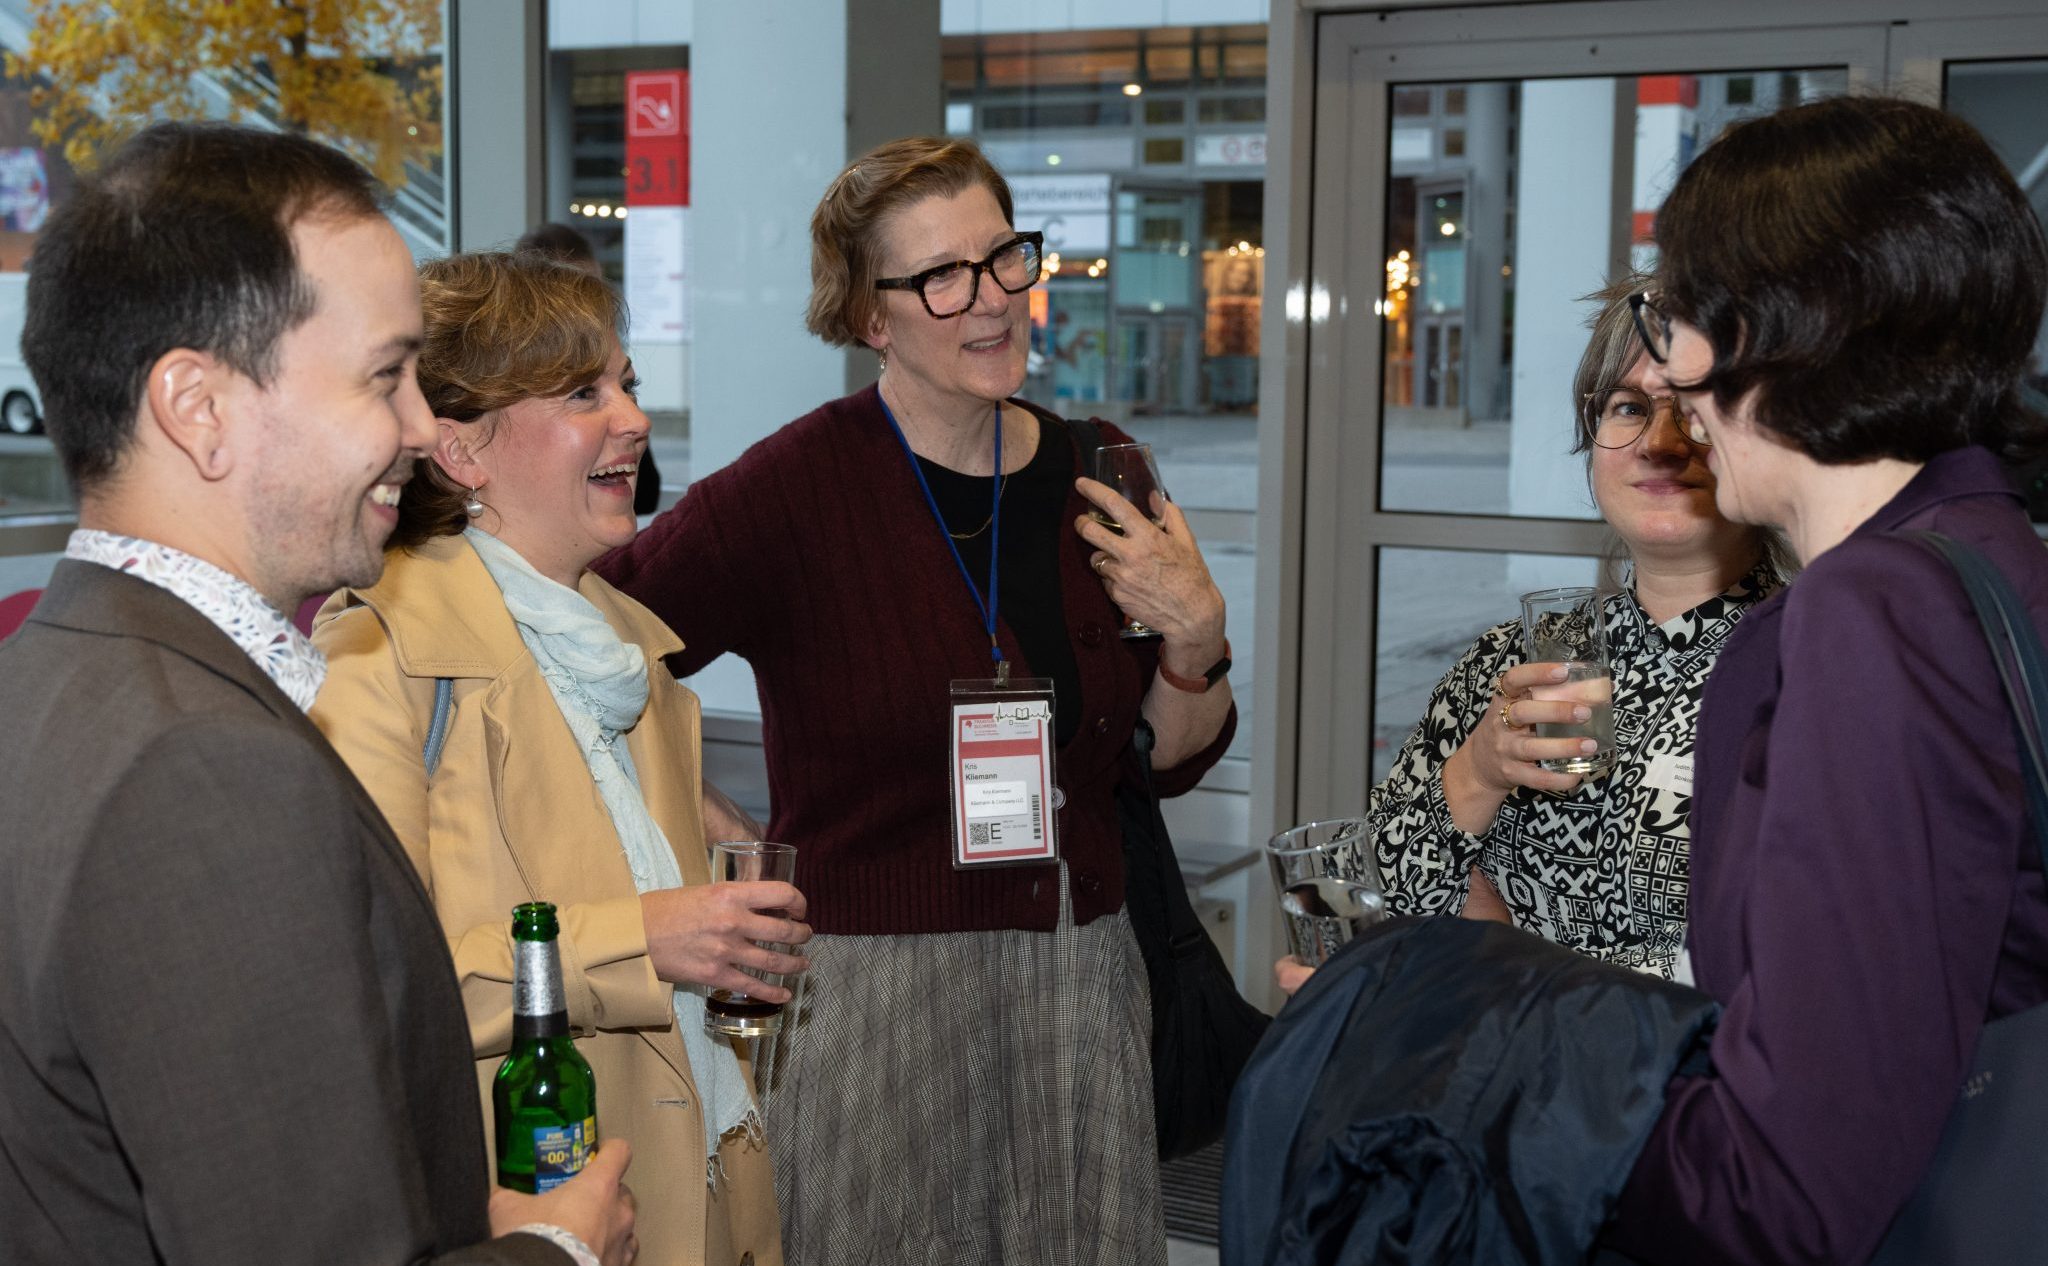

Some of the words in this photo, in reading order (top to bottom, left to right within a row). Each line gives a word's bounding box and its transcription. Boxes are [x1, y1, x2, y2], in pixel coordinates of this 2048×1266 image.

[633, 157, 679, 193] 3.1
[1041, 214, 1066, 247] C
[965, 773, 998, 781] Kliemann
[991, 822, 1002, 840] E
